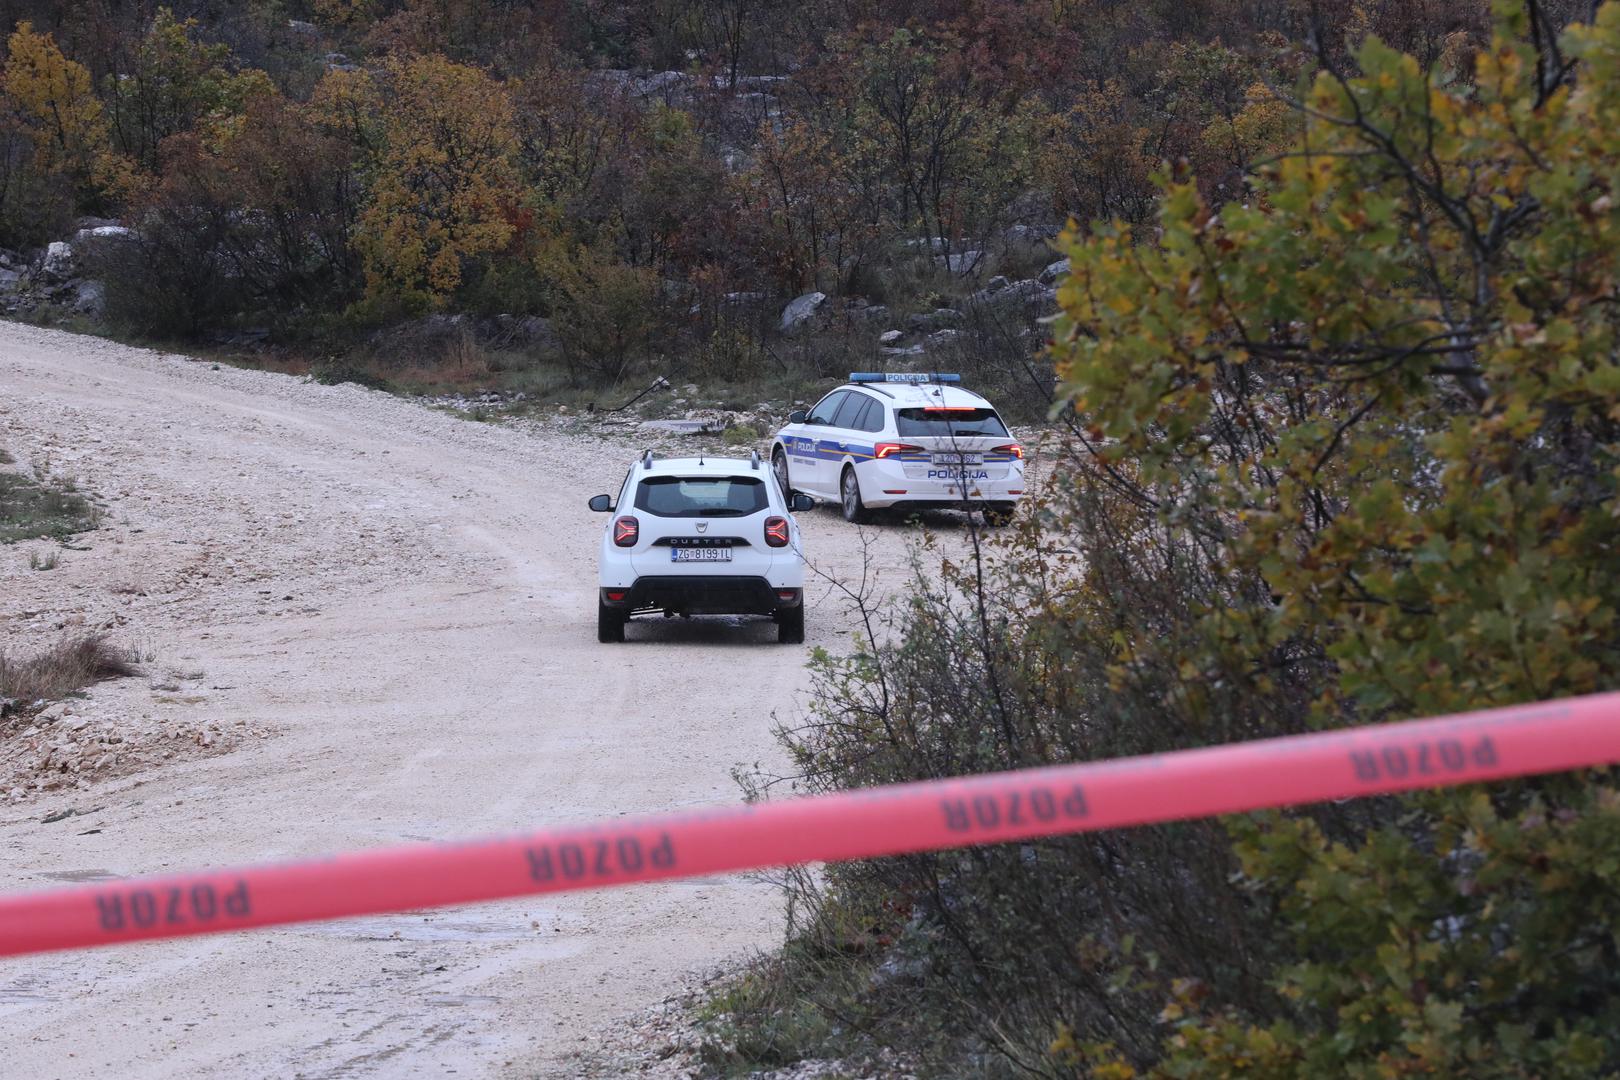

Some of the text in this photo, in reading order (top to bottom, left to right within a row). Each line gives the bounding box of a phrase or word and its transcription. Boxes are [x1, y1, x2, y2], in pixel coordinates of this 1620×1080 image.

[927, 470, 989, 479] POLICIJA
[678, 549, 690, 559] ZG
[1350, 734, 1497, 783] POZOR
[942, 784, 1089, 833] POZOR
[524, 832, 678, 883] POZOR
[94, 880, 252, 931] POZOR
